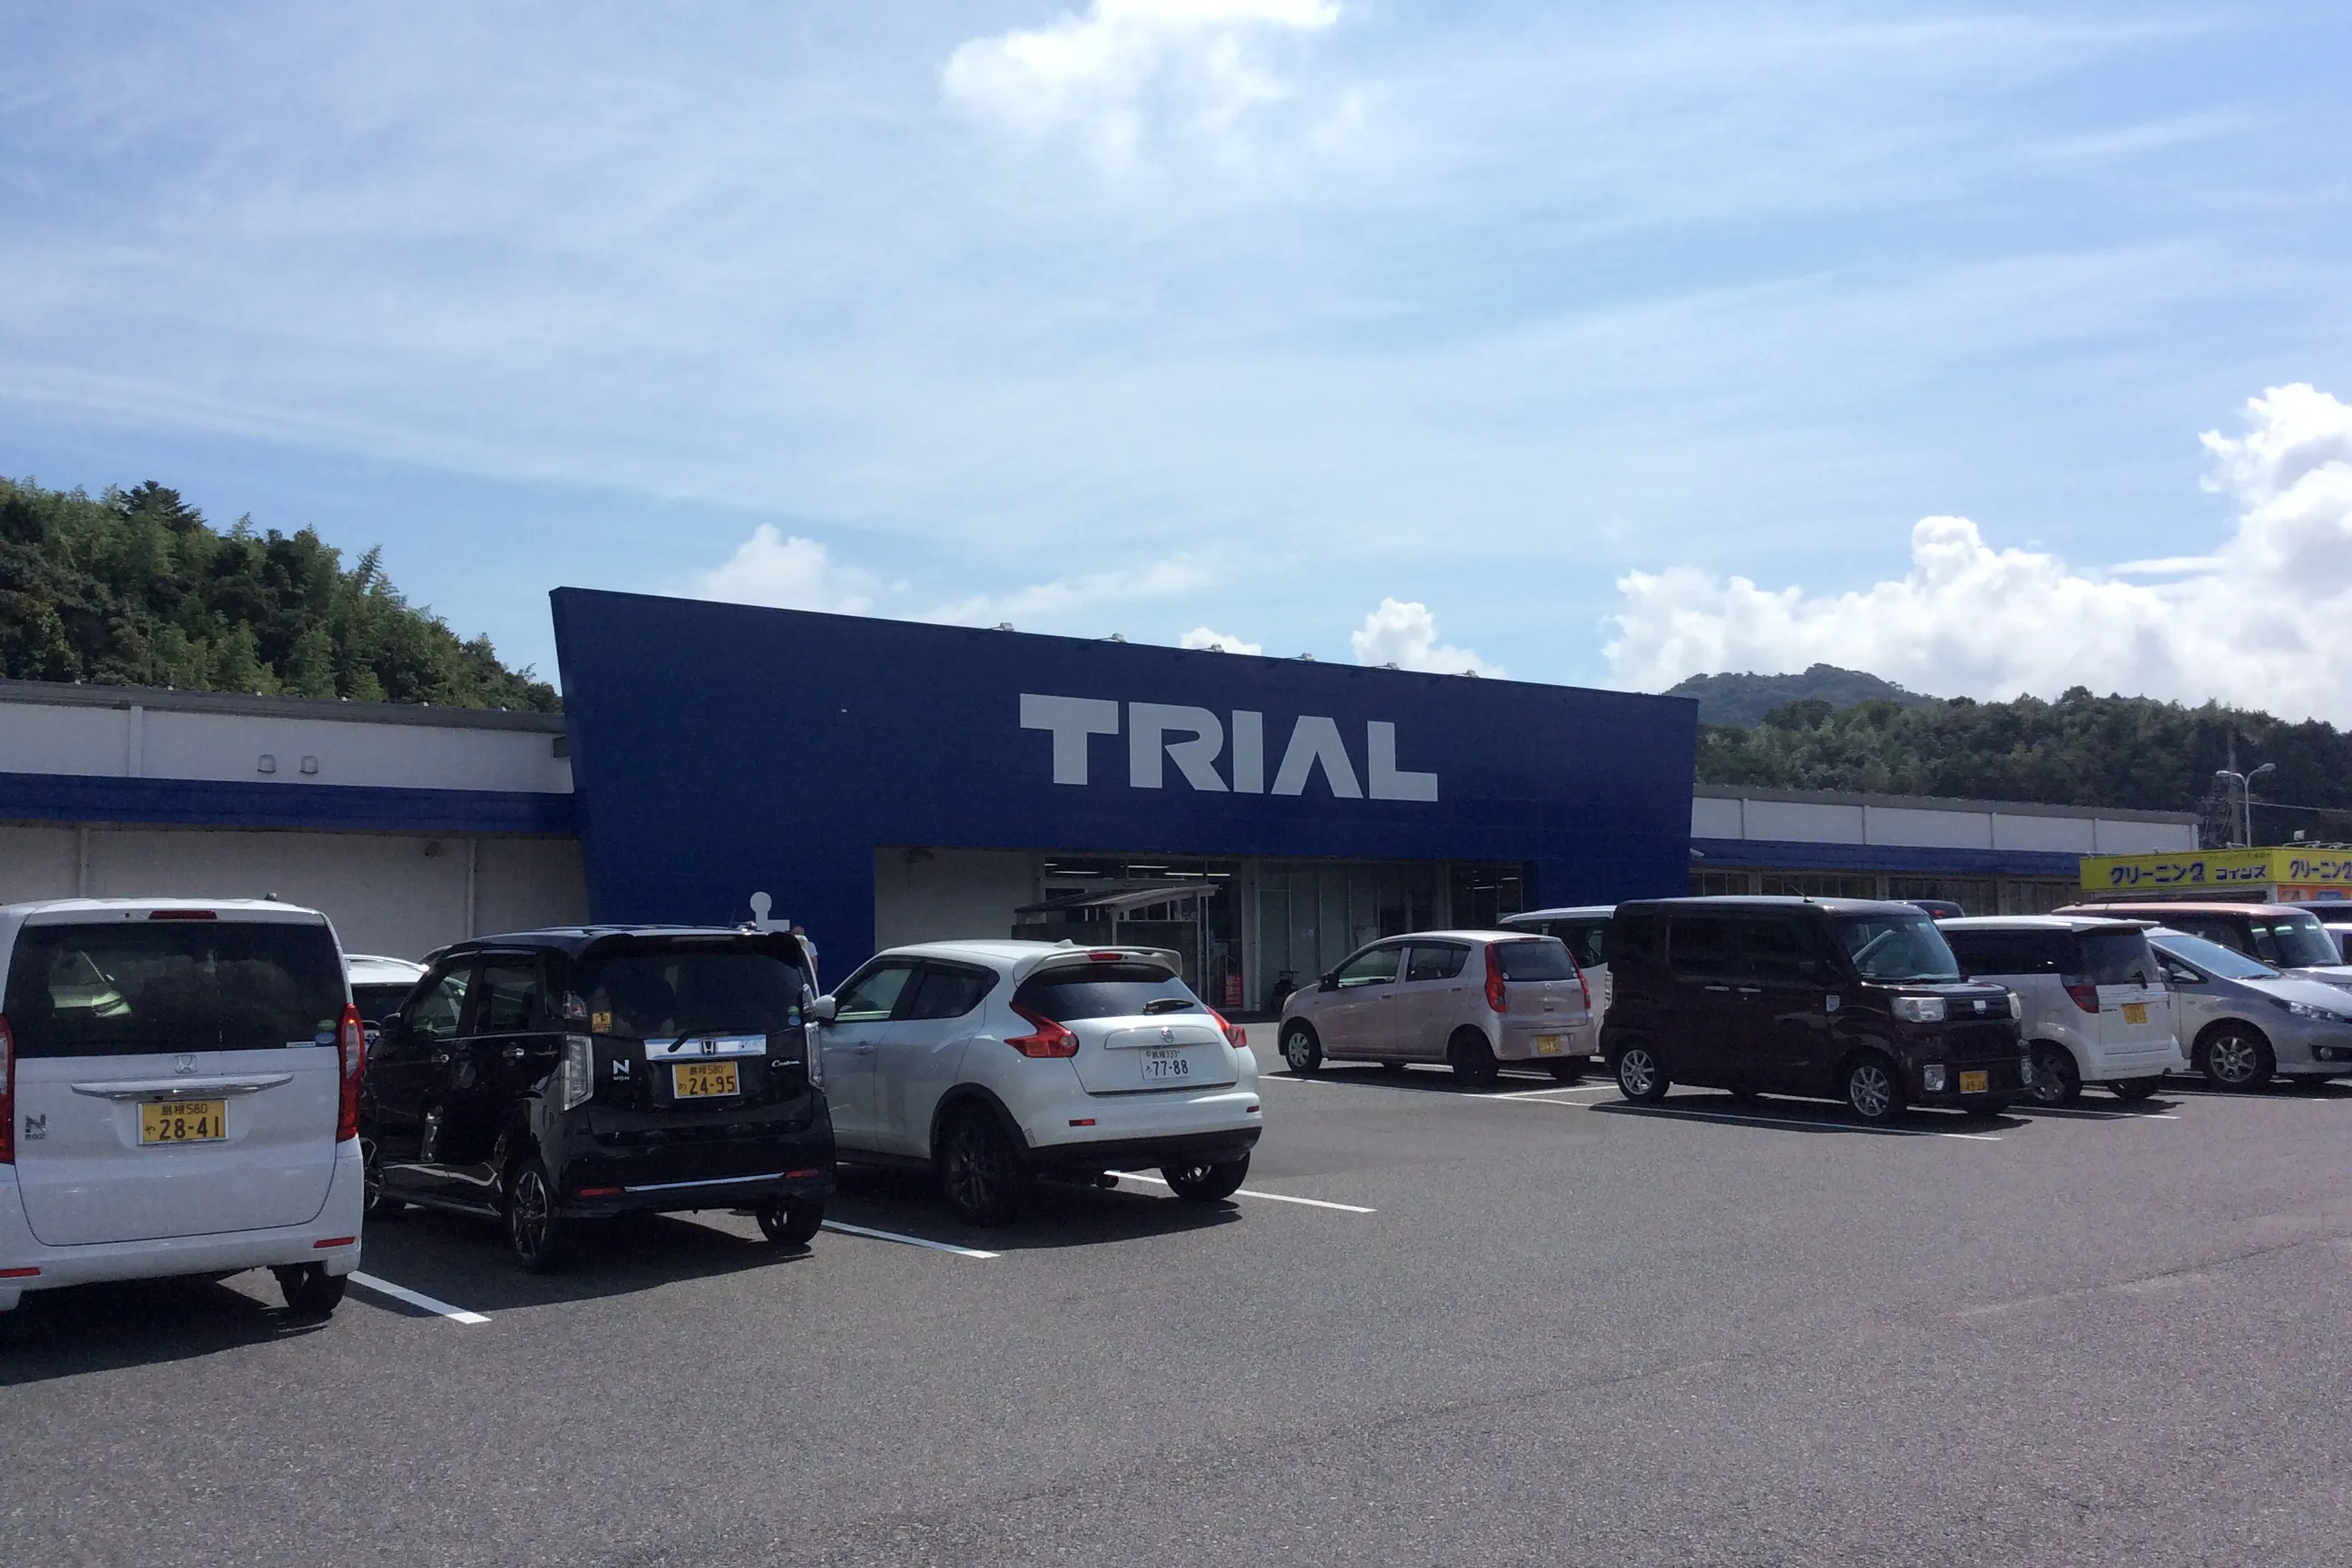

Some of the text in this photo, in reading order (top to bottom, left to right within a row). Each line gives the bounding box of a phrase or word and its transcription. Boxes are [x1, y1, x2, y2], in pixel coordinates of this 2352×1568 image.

[1020, 692, 1438, 802] TRIAL
[2110, 859, 2267, 885] クリーニング コインズ
[689, 1075, 736, 1095] 24-95
[159, 1116, 220, 1141] 28-41
